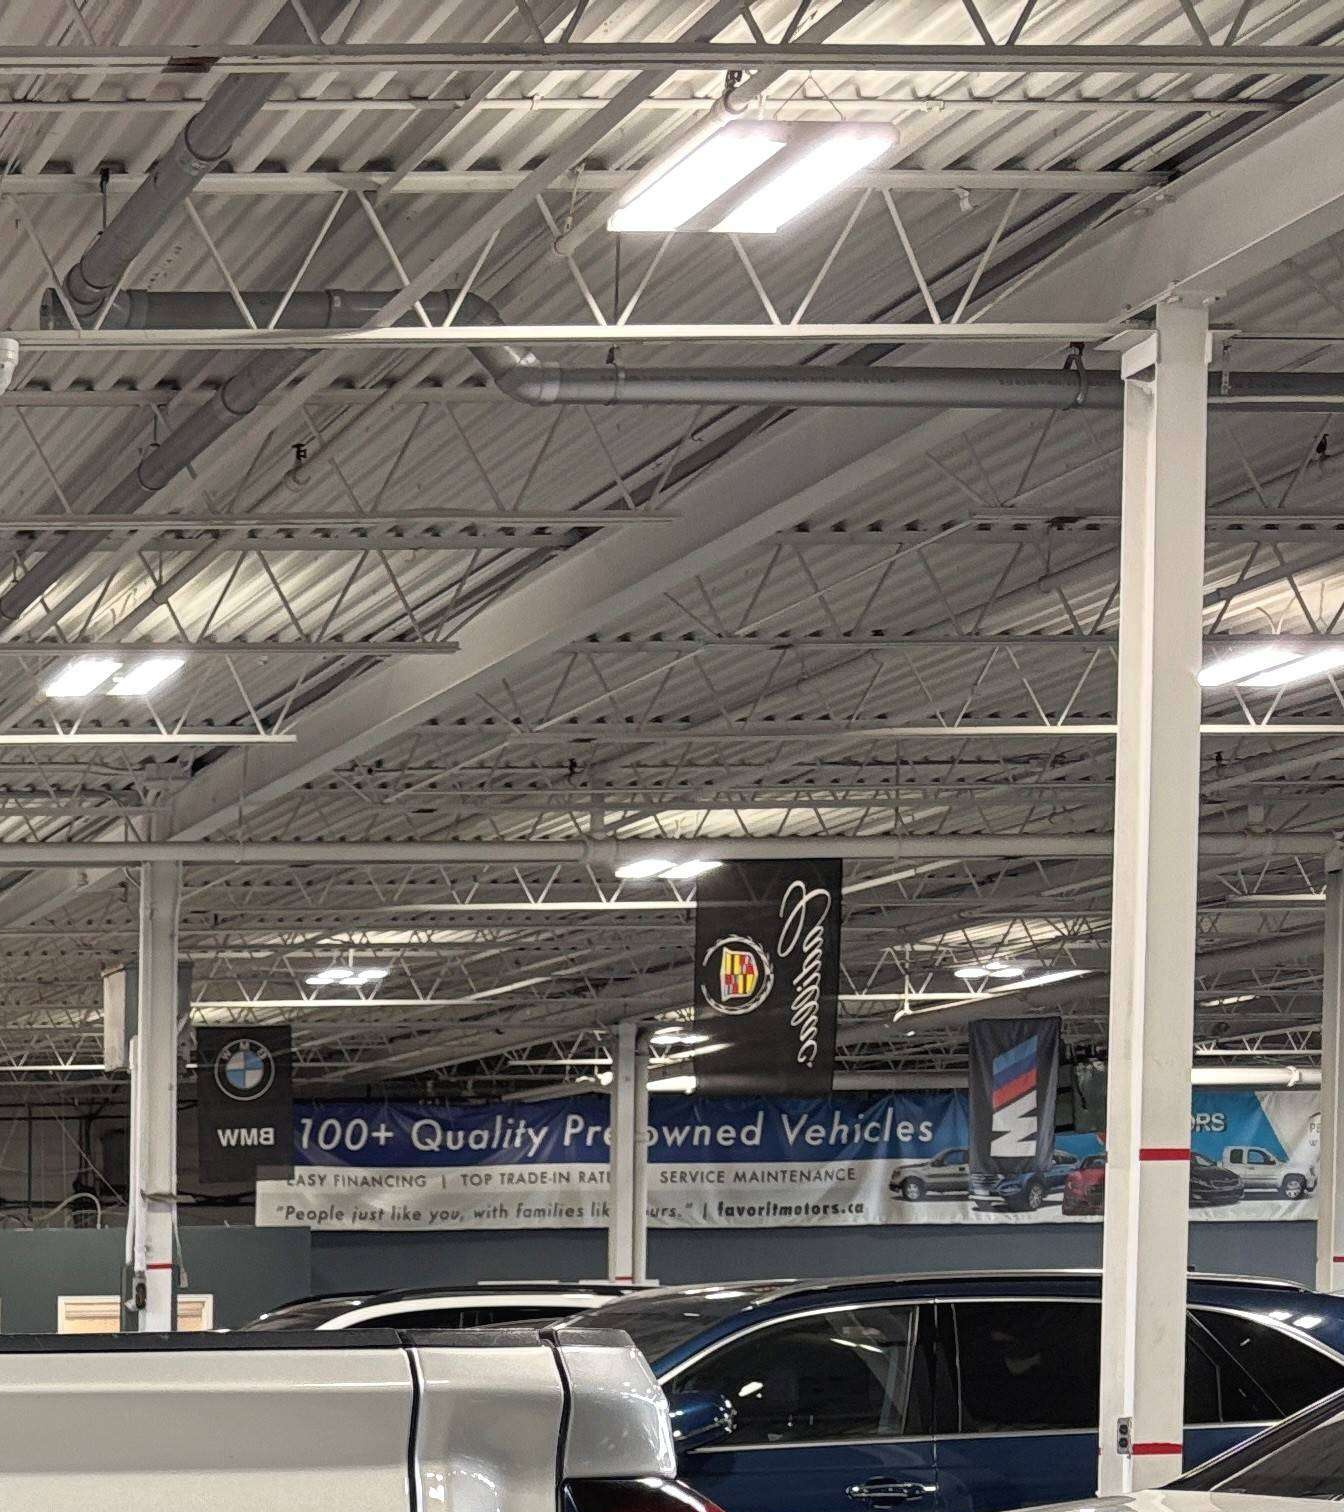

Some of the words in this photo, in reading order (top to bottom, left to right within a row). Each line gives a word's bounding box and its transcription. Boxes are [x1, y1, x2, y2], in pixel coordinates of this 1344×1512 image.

[300, 1117, 394, 1151] 100+
[411, 1114, 549, 1157] Quality
[781, 1107, 934, 1146] Vehicles
[1191, 1112, 1225, 1132] RS
[334, 1174, 427, 1188] FINANCING
[460, 1173, 493, 1187] TOP
[499, 1171, 571, 1185] TRADE-IN
[578, 1170, 610, 1184] RAT
[659, 1170, 725, 1184] SERVICE
[732, 1167, 857, 1184] MAINTENANCE
[351, 1204, 385, 1224] just
[390, 1204, 422, 1221] like
[429, 1208, 464, 1223] you,
[474, 1203, 509, 1219] with
[515, 1201, 584, 1219] families
[590, 1201, 610, 1219] lik
[717, 1200, 865, 1218] favoritmotors.ca
